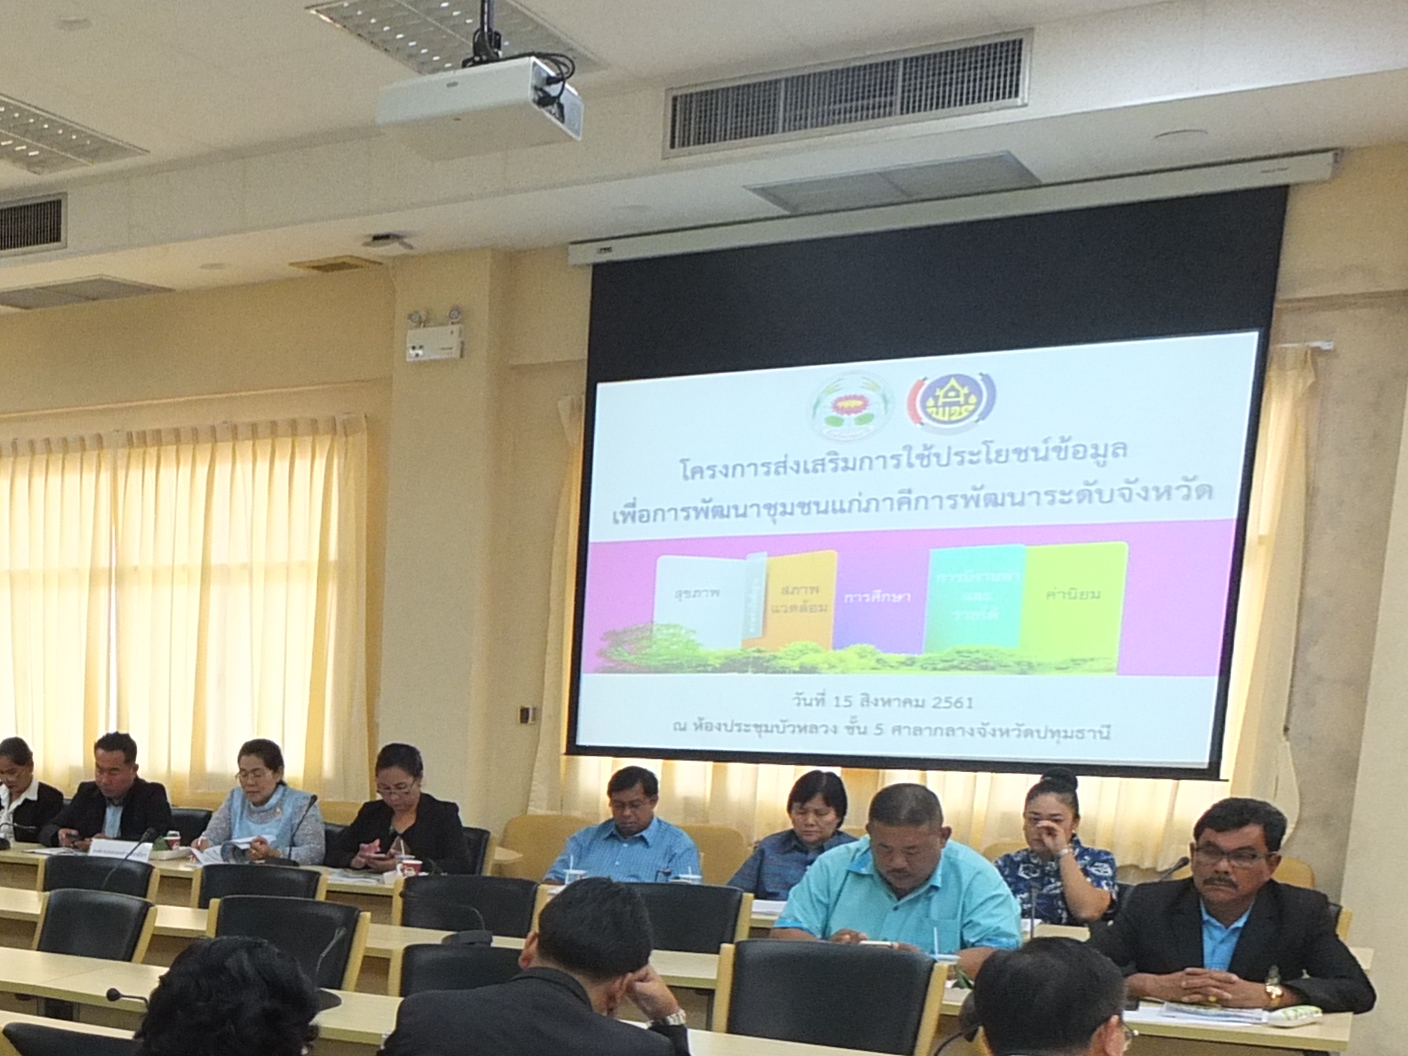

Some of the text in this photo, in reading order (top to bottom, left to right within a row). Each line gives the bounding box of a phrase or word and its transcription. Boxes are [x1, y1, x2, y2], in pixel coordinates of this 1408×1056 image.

[679, 435, 1128, 482] โครงการส่งเสริมการใช้ประโยชน์ข้อมูล
[612, 474, 1214, 526] เพื่อการพัฒนาชุมชนแก่ภาคีการพัฒนาระดับจังหวัด
[674, 588, 721, 602] สุขภาพ
[843, 589, 912, 604] การศึกษา
[792, 688, 974, 710] วันที่ 15 สิงหาคม 2561
[673, 714, 1112, 745] ณ ห้องประชุมบัวหลวง ชั้น 5 ศาลากลางจังหวัดปทุมธานี
